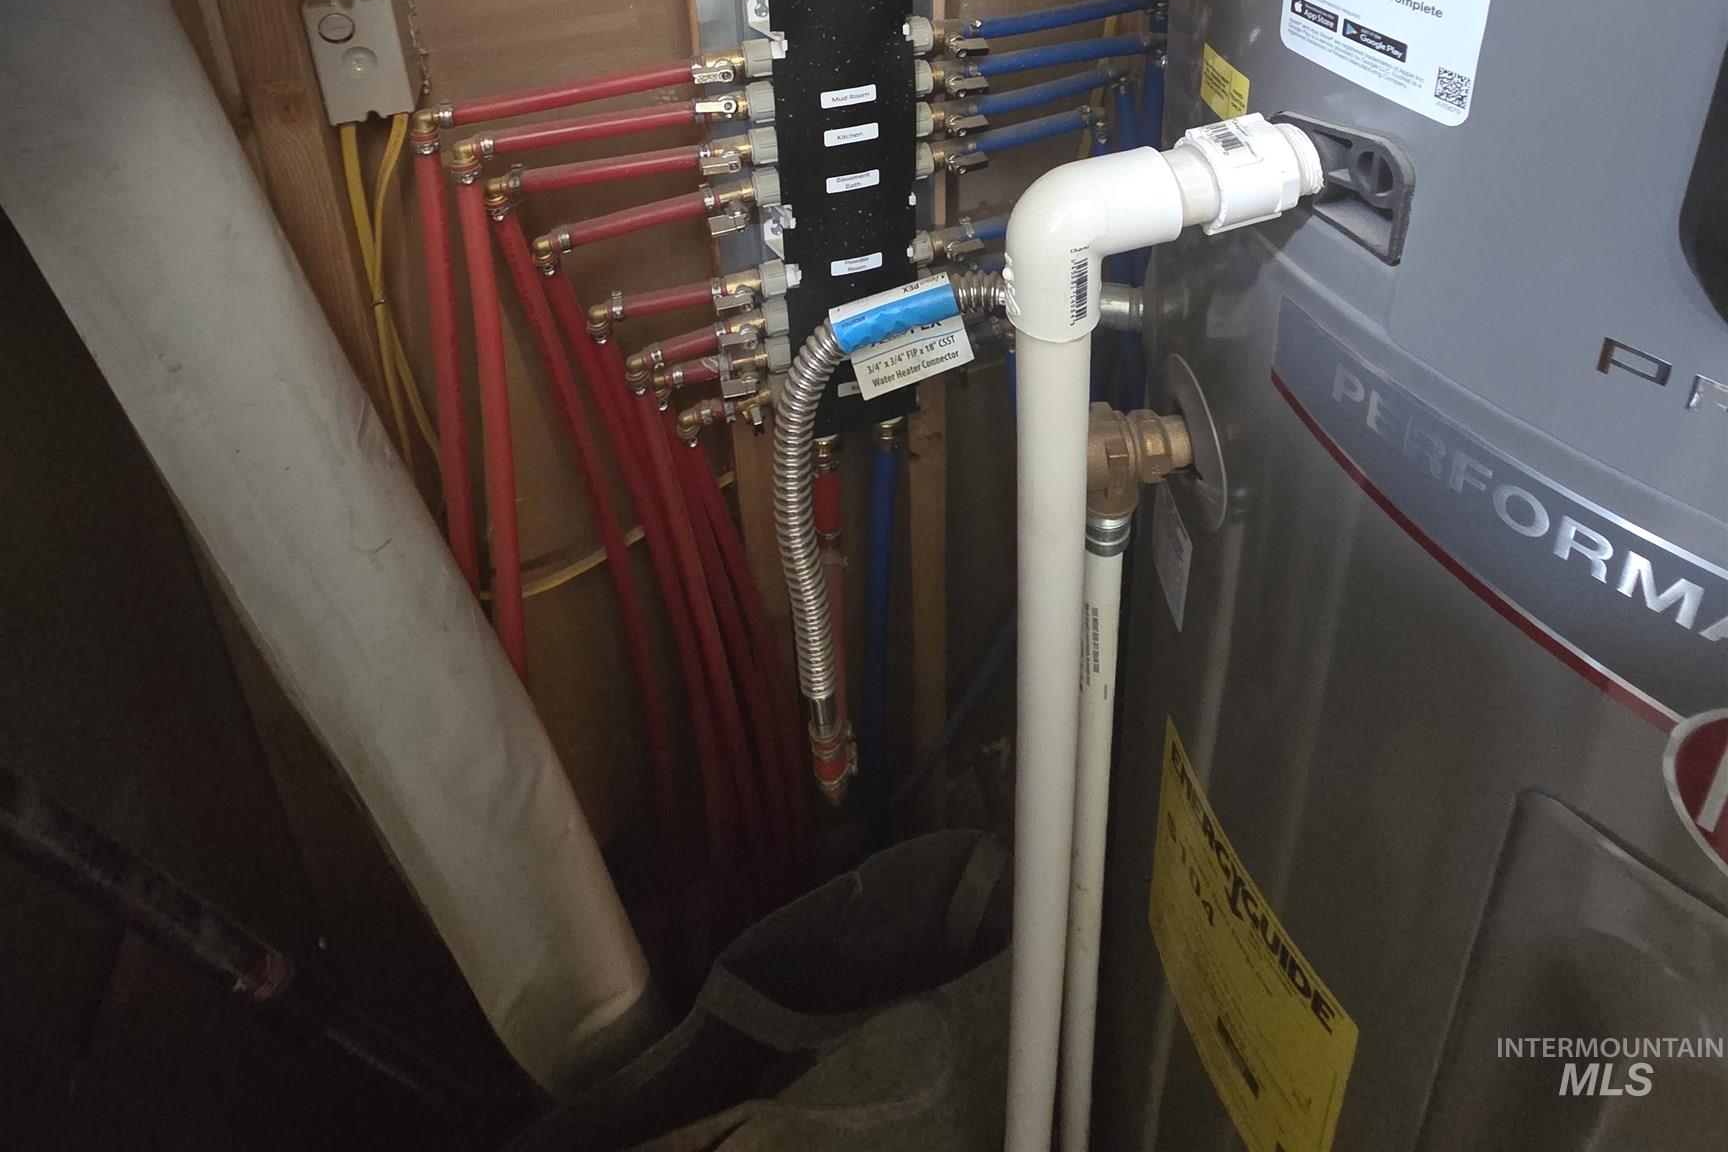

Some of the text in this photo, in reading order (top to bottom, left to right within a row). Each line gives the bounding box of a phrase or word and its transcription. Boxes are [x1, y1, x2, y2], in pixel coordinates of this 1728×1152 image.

[1303, 9, 1335, 29] App Store
[1359, 33, 1386, 52] Google
[1386, 43, 1403, 59] Play
[832, 94, 848, 103] Mud
[837, 131, 864, 141] Kitchen
[906, 347, 918, 360] FIP
[938, 335, 956, 348] CSST
[872, 350, 960, 388] Water Heater Connector
